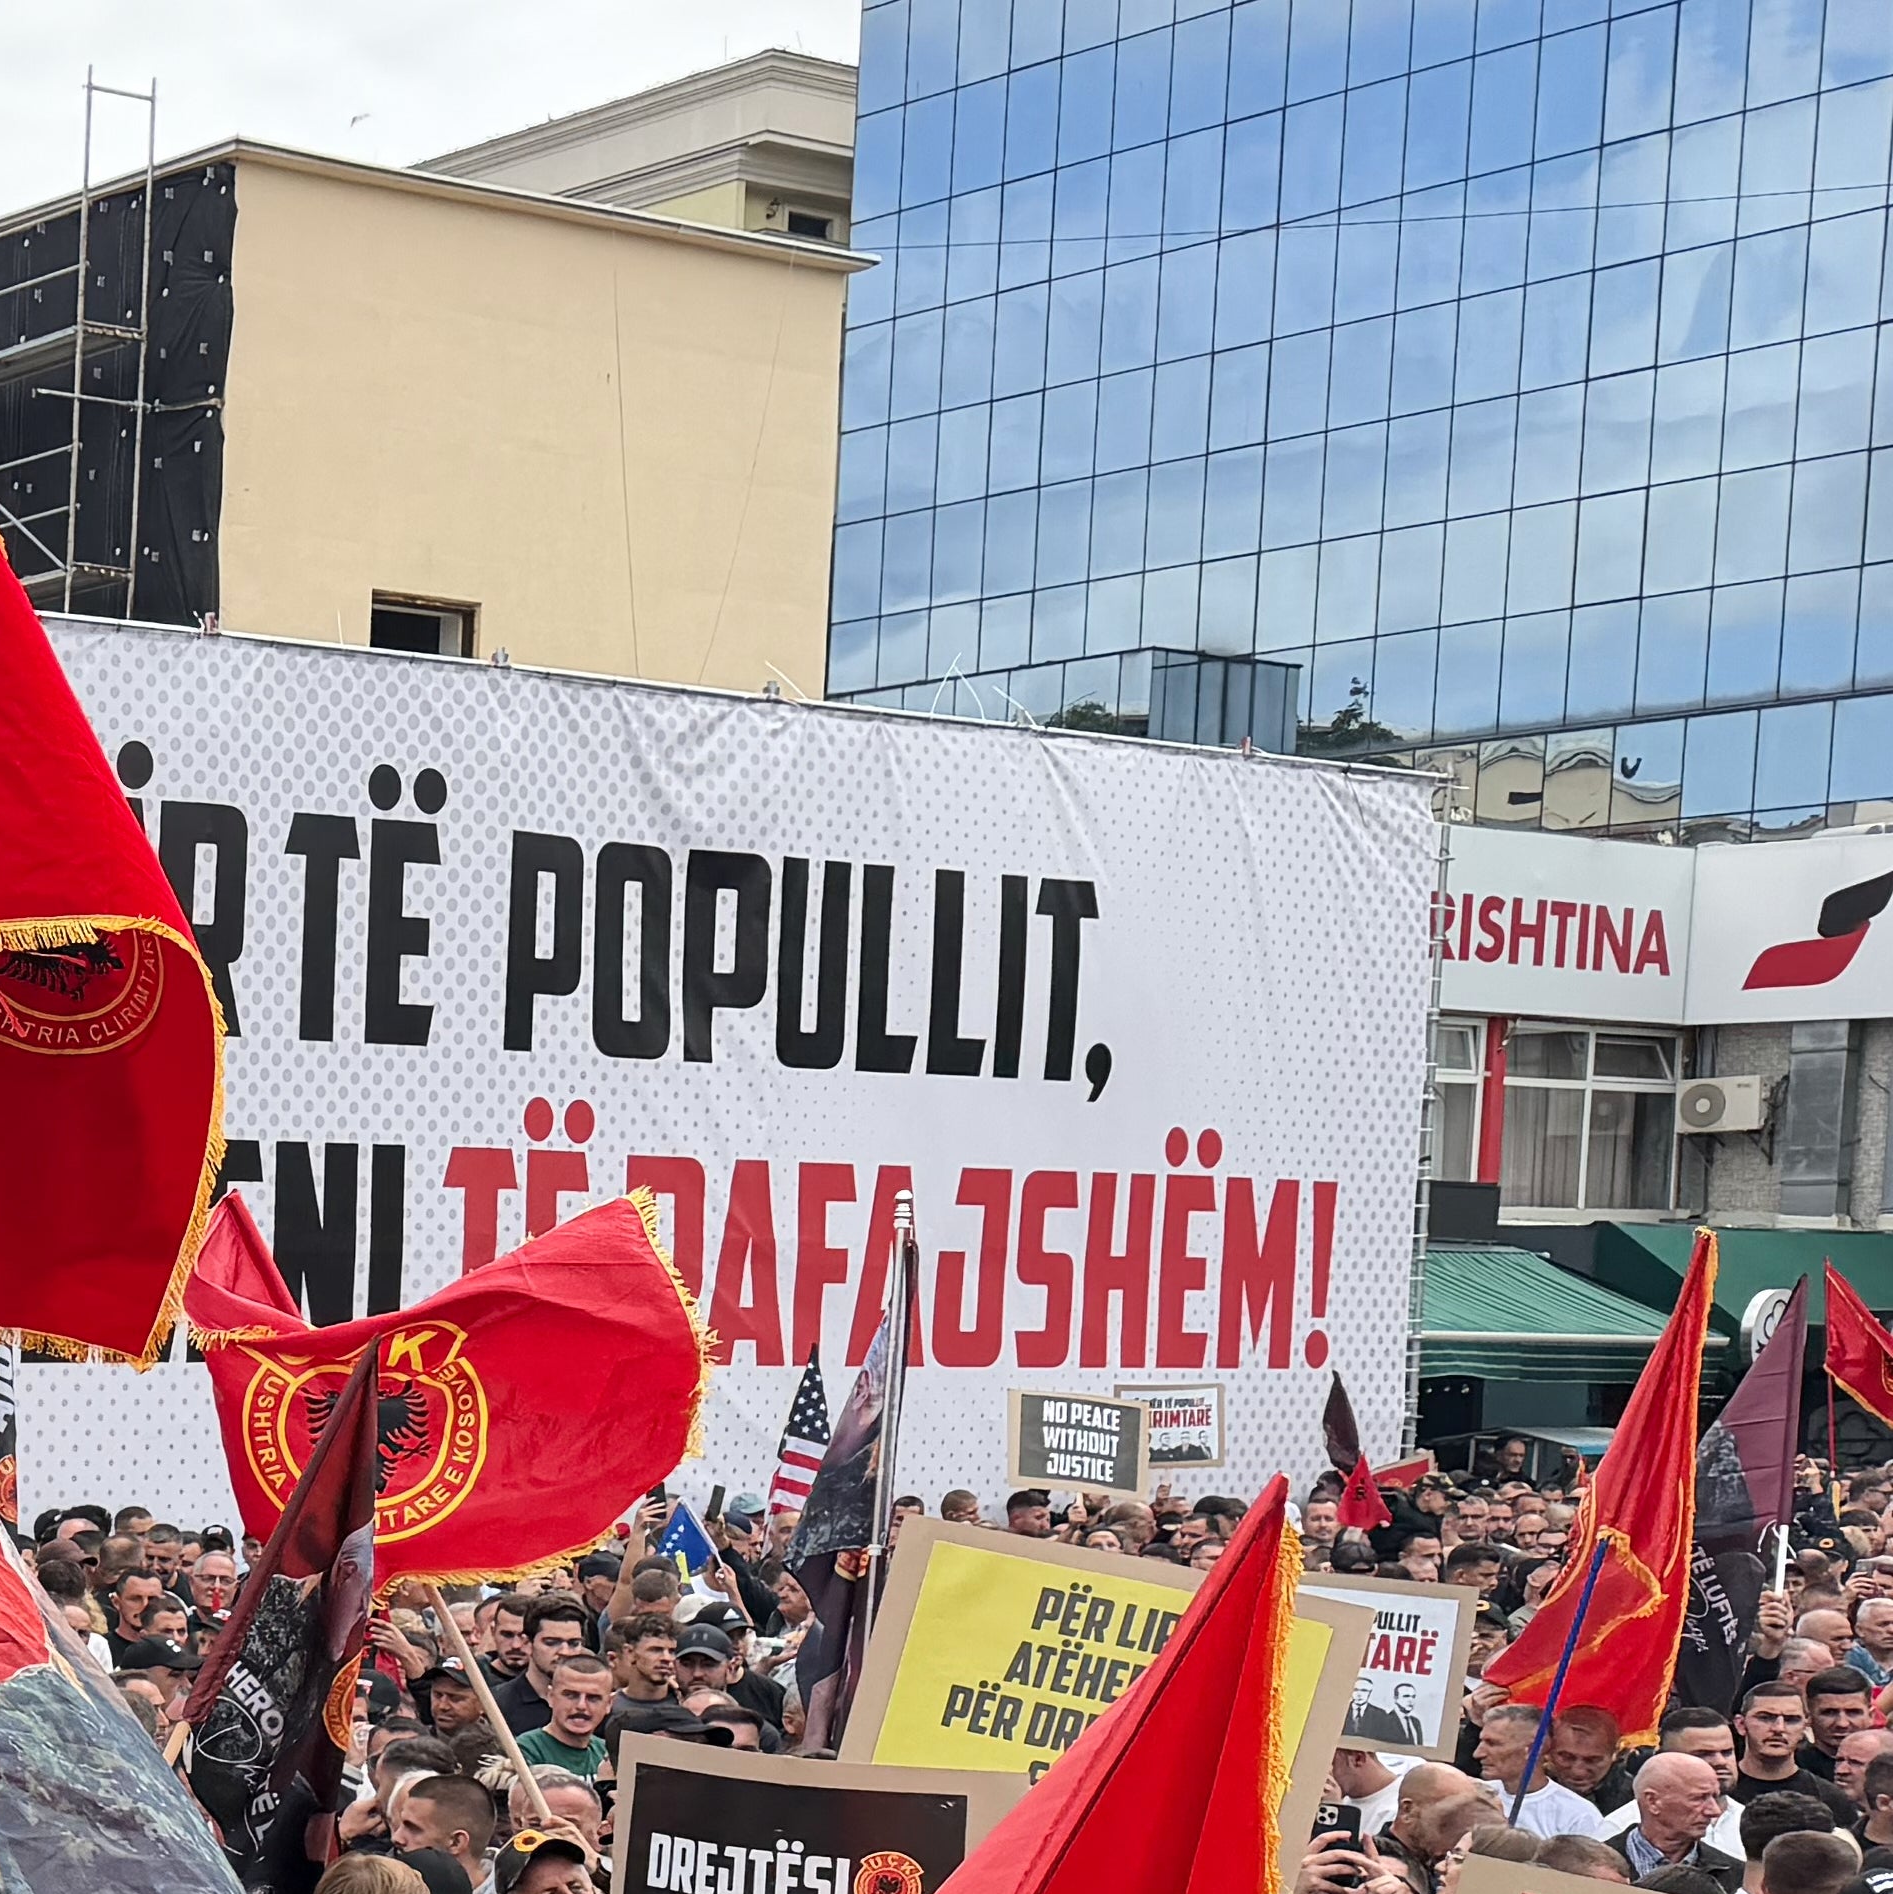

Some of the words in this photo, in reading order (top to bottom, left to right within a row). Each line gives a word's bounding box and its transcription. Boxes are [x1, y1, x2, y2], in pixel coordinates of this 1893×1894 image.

[285, 763, 448, 1046] TË
[503, 830, 1112, 1103] POPULLIT,
[253, 1374, 288, 1490] USHTRIA
[374, 1484, 451, 1531] TARE
[433, 1363, 475, 1464] KOSOVË
[1042, 1400, 1067, 1423] NO
[1069, 1403, 1122, 1431] PEACE
[1042, 1426, 1120, 1457] WITHOUT
[1046, 1453, 1114, 1482] JUSTICE
[1030, 1582, 1116, 1643] PËR
[224, 1659, 285, 1748] HERO
[941, 1680, 1024, 1741] PËR
[1024, 1702, 1100, 1752] DR
